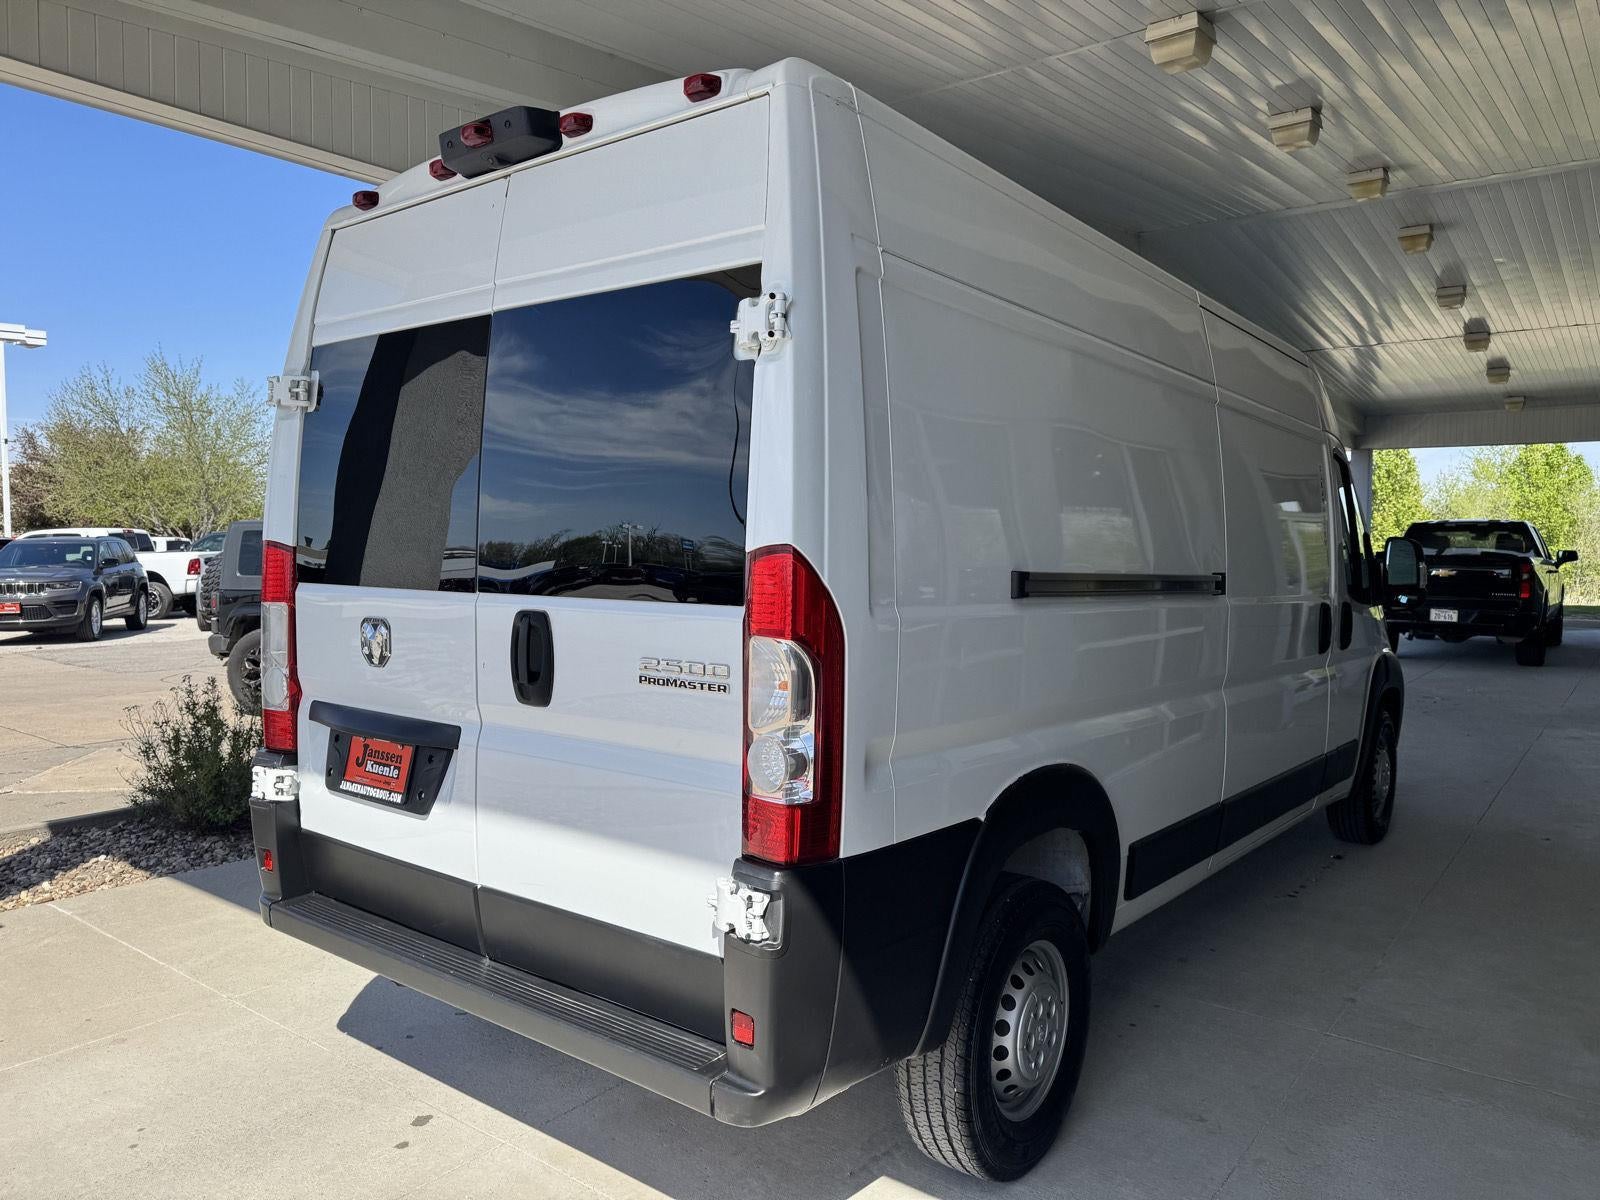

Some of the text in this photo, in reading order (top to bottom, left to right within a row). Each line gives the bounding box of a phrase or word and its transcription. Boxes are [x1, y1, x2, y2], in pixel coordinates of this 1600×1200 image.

[638, 656, 730, 679] 2500
[355, 743, 403, 768] Janssen
[365, 760, 399, 778] Kuenle
